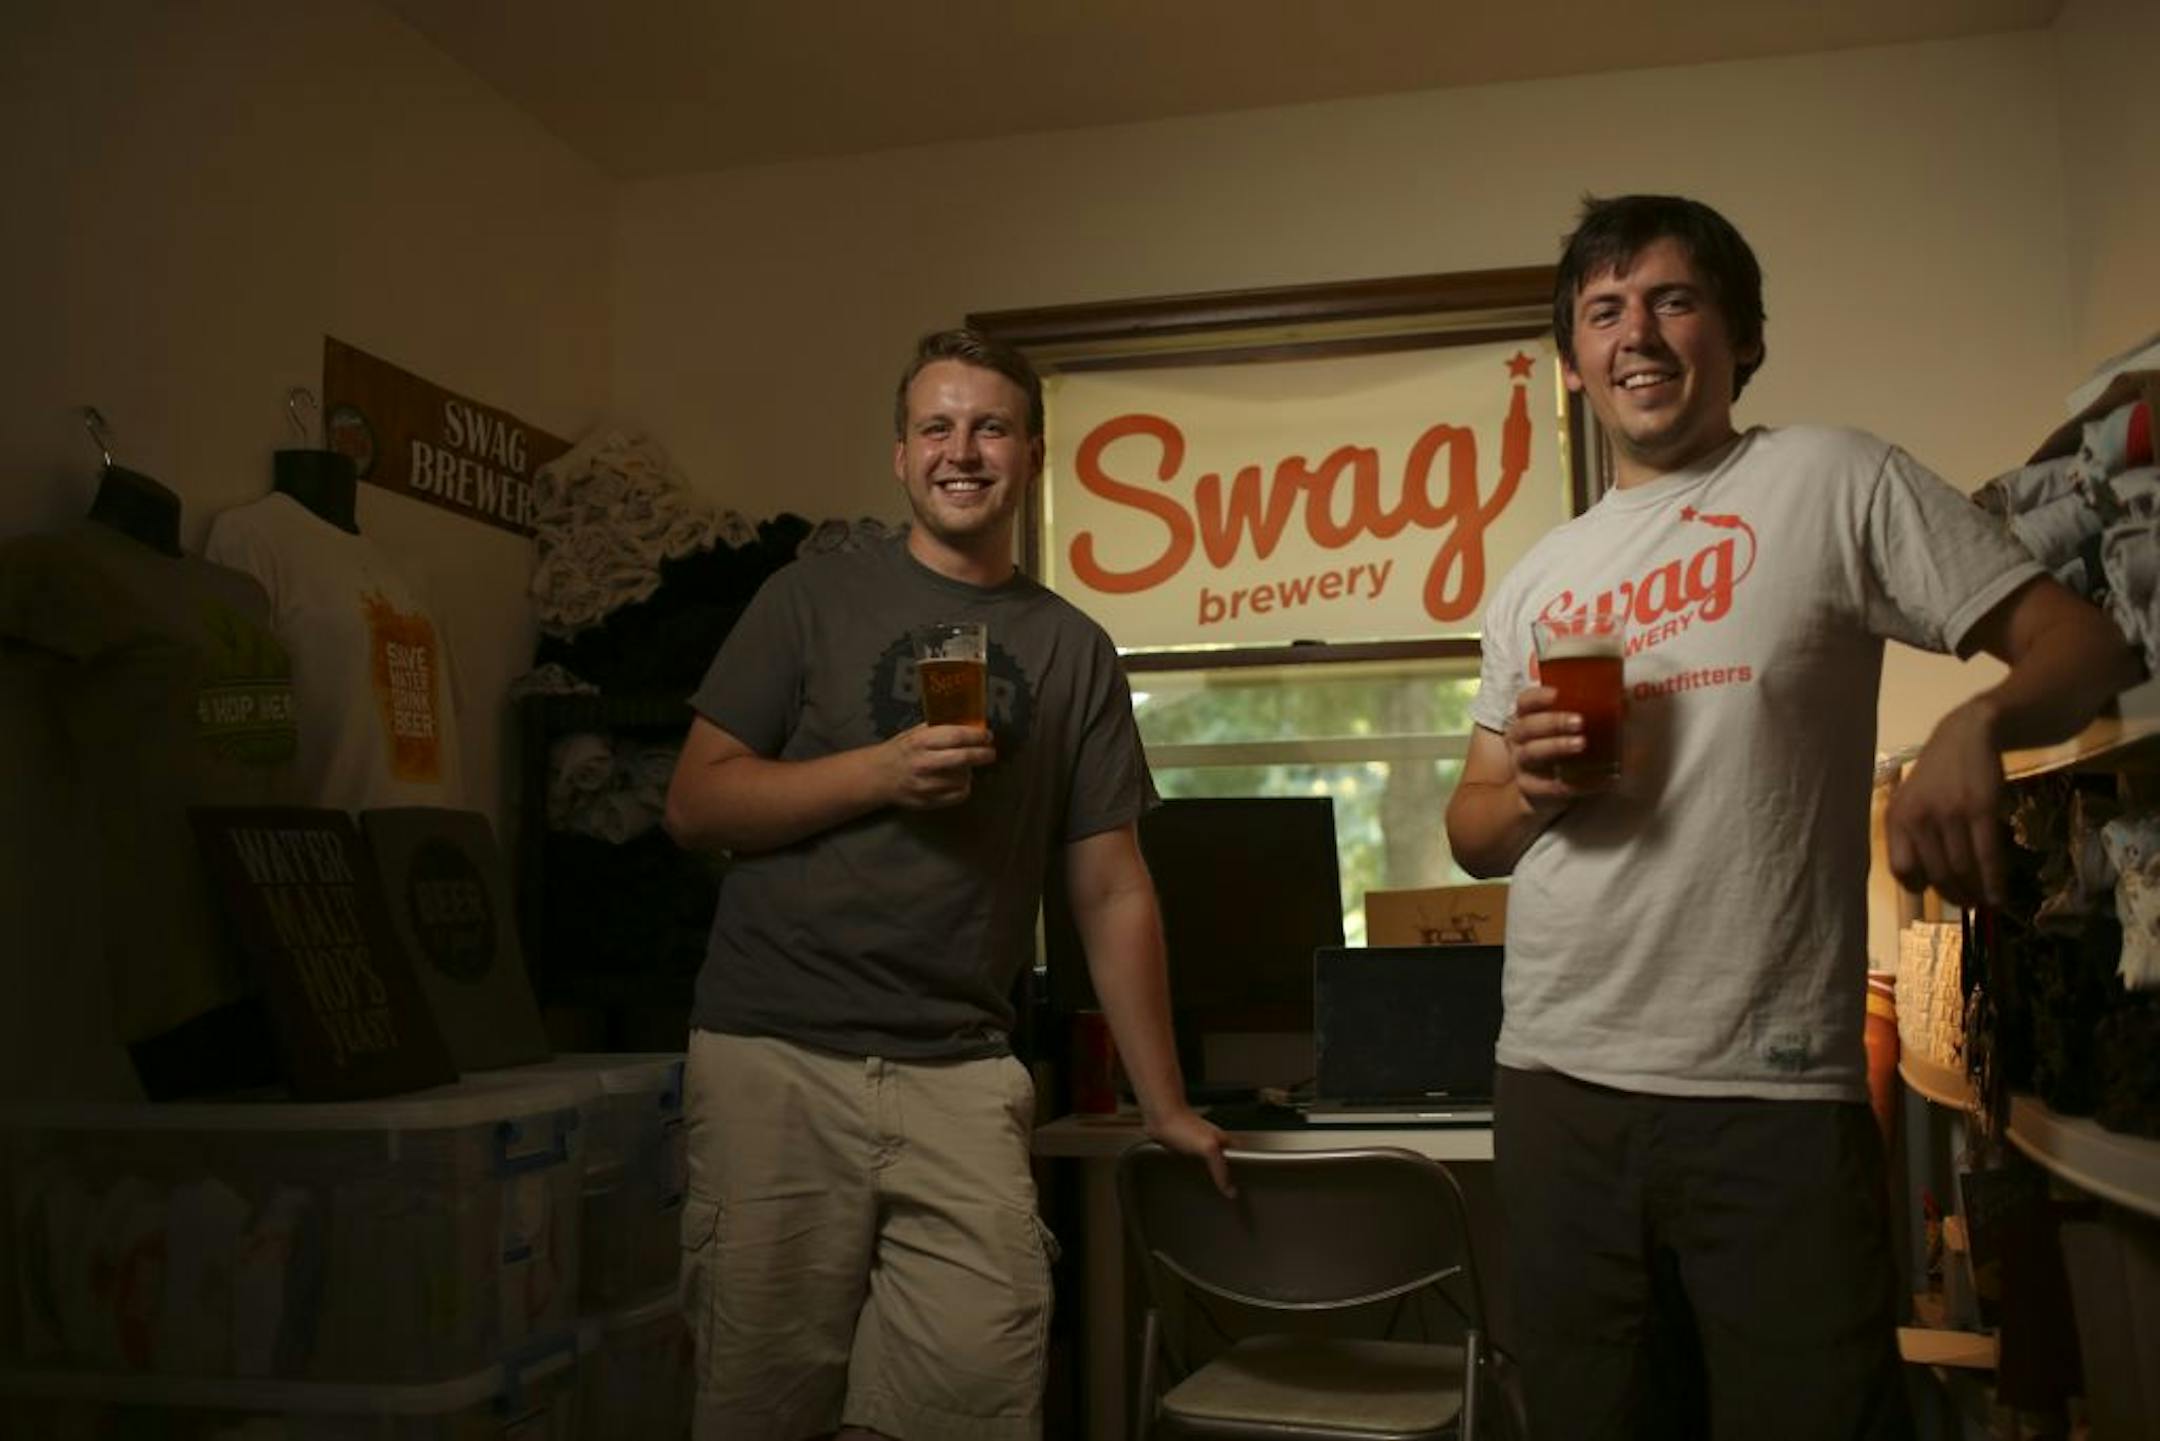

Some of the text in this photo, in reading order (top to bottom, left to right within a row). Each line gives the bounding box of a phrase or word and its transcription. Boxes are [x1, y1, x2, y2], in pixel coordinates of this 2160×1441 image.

[445, 399, 529, 474] SWAG
[1070, 386, 1531, 622] Swag
[1199, 559, 1393, 625] brewery
[386, 640, 429, 671] SAVE
[1624, 610, 1696, 659] WERY
[1633, 664, 1753, 702] Outfitters
[394, 710, 433, 738] BEER
[225, 827, 356, 884] WATER
[260, 884, 366, 947] MALT
